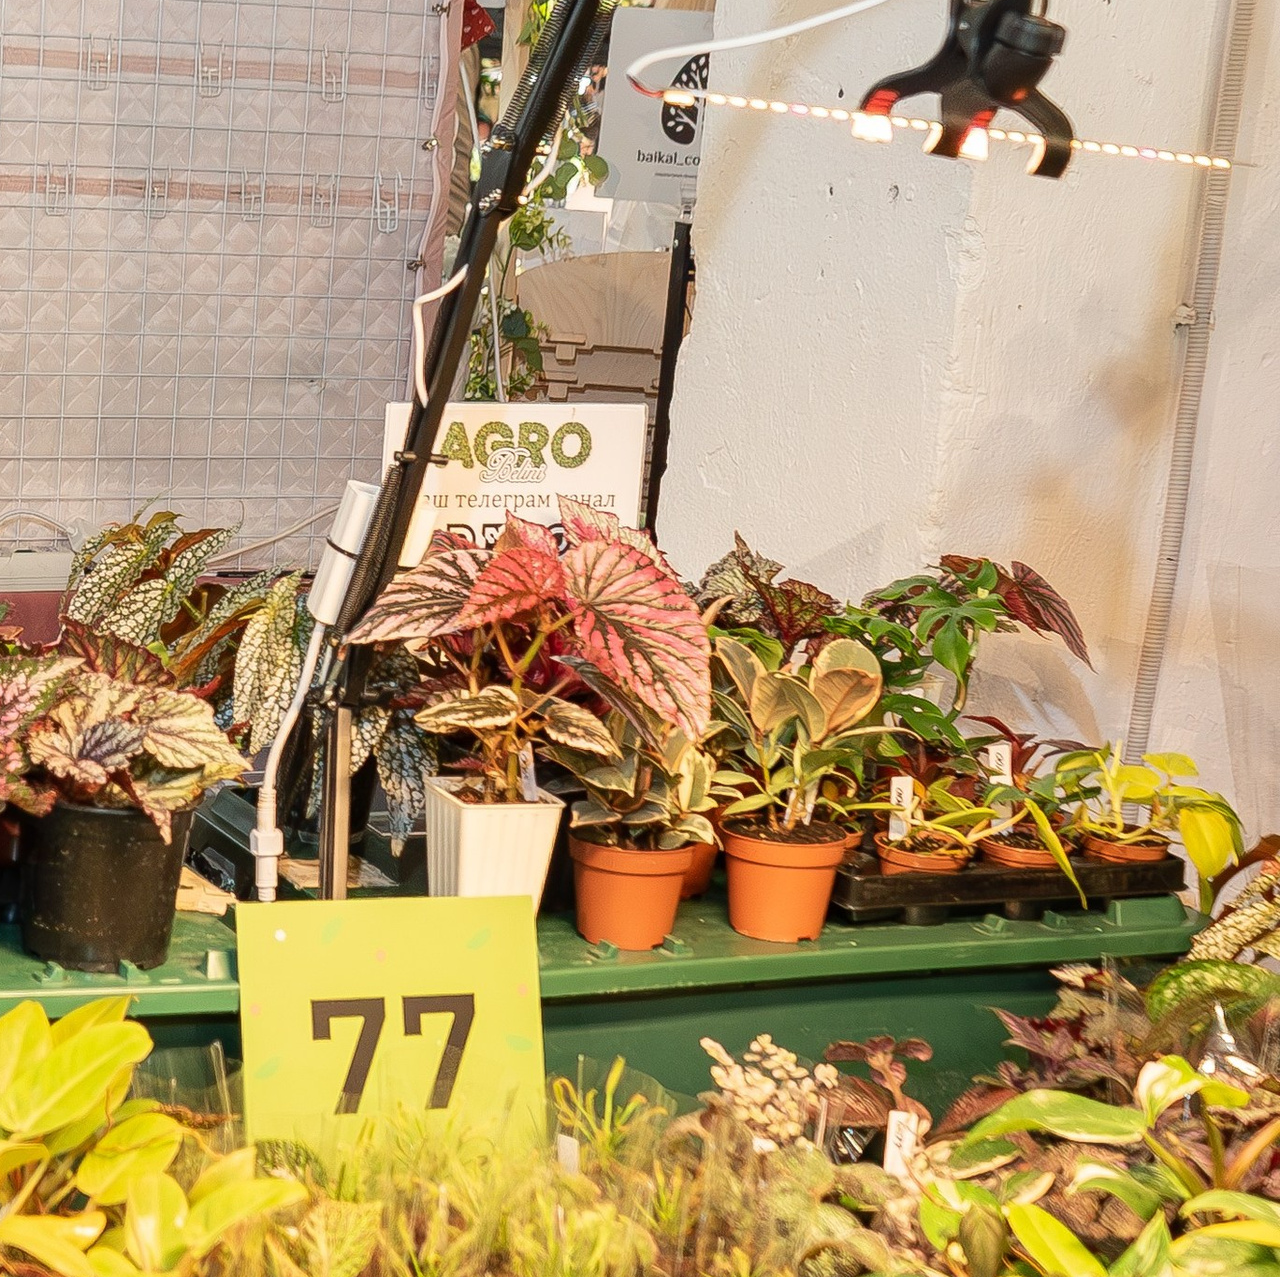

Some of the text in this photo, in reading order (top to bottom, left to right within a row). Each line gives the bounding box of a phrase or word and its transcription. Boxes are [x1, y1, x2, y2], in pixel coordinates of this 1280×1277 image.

[436, 421, 592, 469] AGRO
[456, 493, 550, 512] телеграм
[310, 993, 475, 1115] 77
